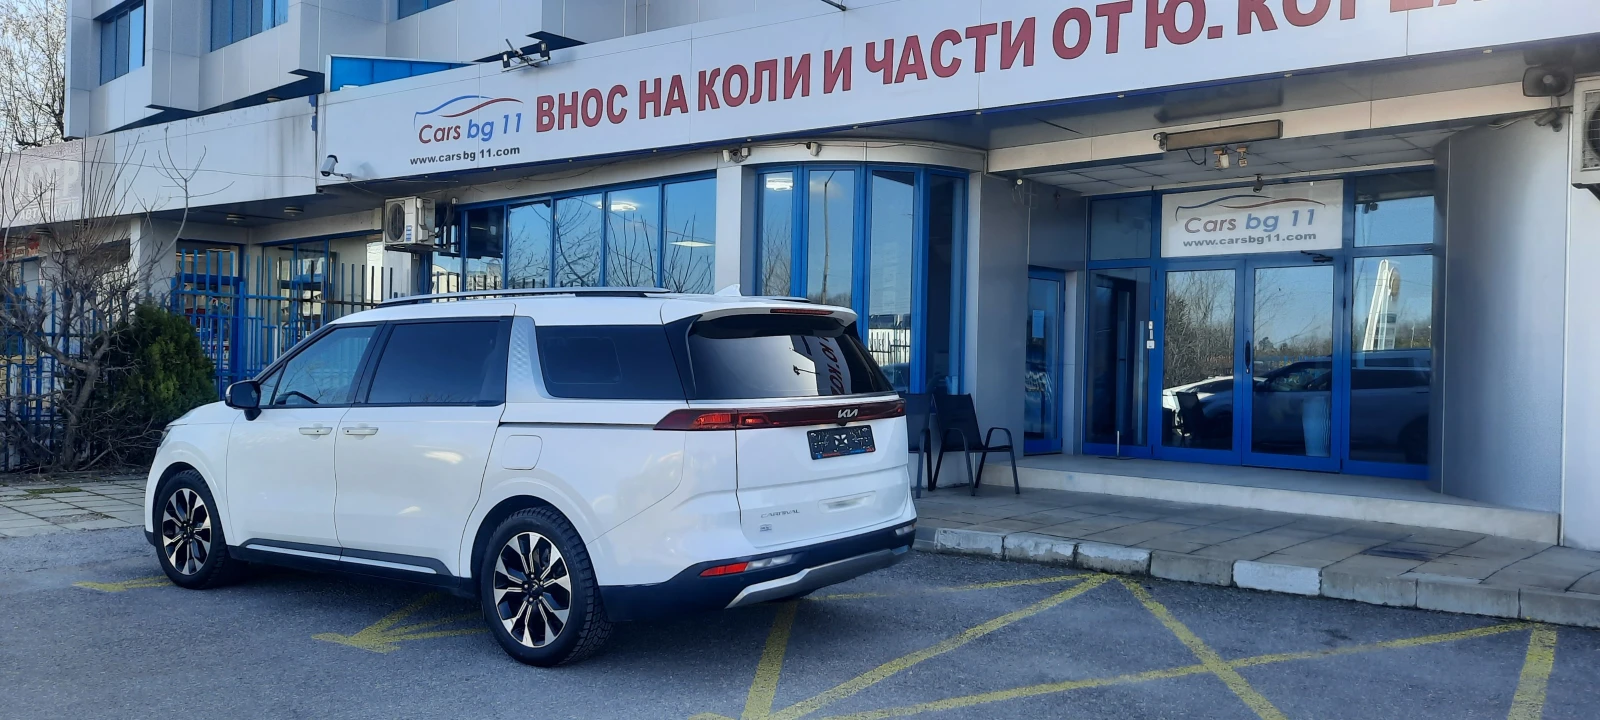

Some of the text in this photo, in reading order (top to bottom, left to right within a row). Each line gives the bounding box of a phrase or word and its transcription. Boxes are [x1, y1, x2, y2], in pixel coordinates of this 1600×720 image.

[536, 84, 628, 132] ВНОС
[638, 74, 689, 120] НА
[698, 53, 811, 111] КОЛИ
[823, 46, 852, 94] И
[865, 17, 1036, 85] ЧАСТИ
[1052, 0, 1133, 59] ОТ
[1144, 0, 1223, 49] Ю.
[419, 113, 522, 143] Cars bg 11
[1184, 208, 1315, 234] Cars bg 11
[1183, 233, 1317, 247] www.carsbg11.com
[837, 408, 859, 419] KIA
